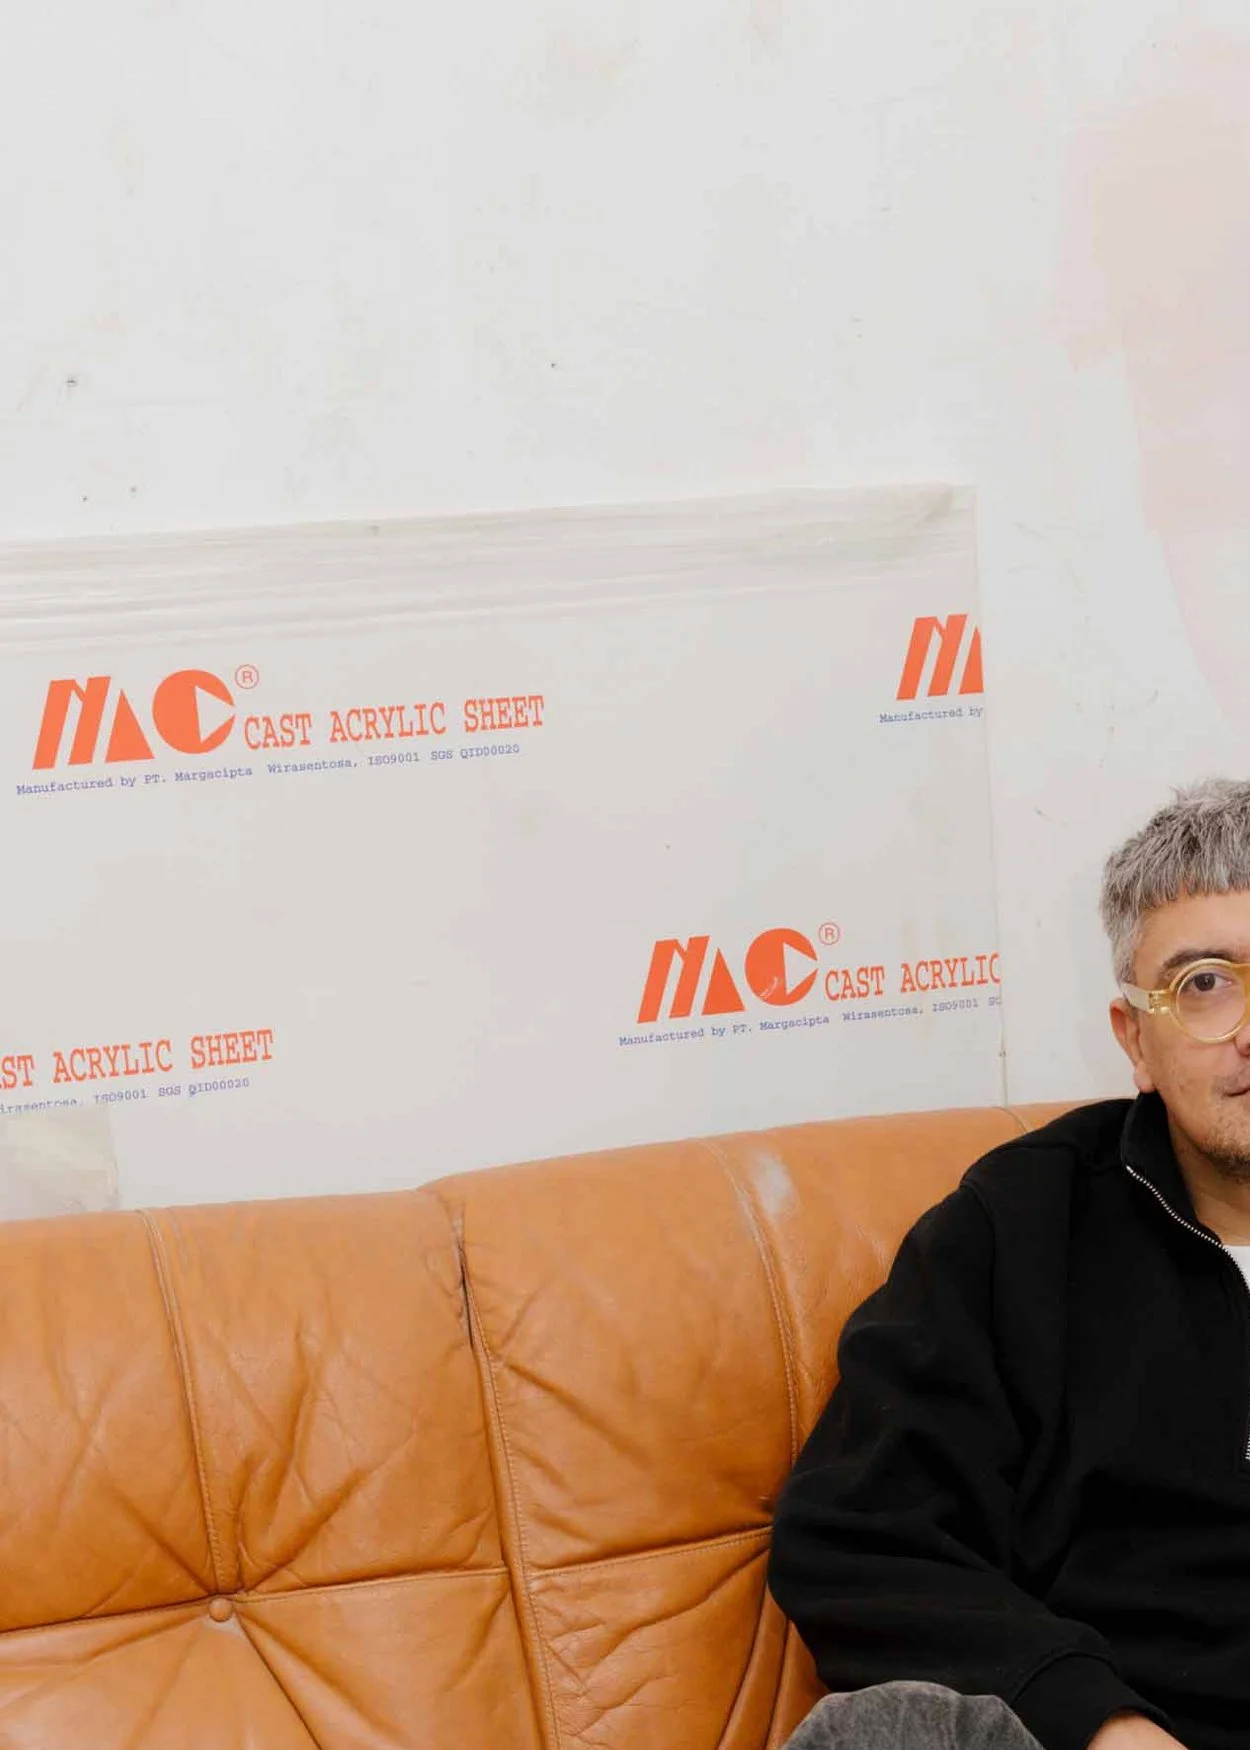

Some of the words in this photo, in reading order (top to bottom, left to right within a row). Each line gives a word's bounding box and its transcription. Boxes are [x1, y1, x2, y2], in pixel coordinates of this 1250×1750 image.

[244, 712, 313, 751] CAST
[329, 701, 448, 744] ACRYLIC
[463, 694, 545, 734] SHEET
[16, 777, 114, 796] Manufactured
[120, 774, 137, 788] by
[144, 773, 167, 786] PT.
[174, 766, 254, 783] Margacipta
[267, 756, 359, 774] Wirasentosa,
[430, 748, 454, 762] SGS
[824, 964, 886, 1002] CAST
[900, 951, 1002, 994] ACRYLIC
[618, 1027, 705, 1047] Manufactured
[710, 1025, 727, 1037] by
[732, 1023, 752, 1035] PT.
[759, 1014, 831, 1032] Margacipta
[0, 1053, 36, 1090] ST
[52, 1039, 174, 1085] ACRYLIC
[189, 1027, 274, 1070] SHEET
[158, 1085, 182, 1098] SGS
